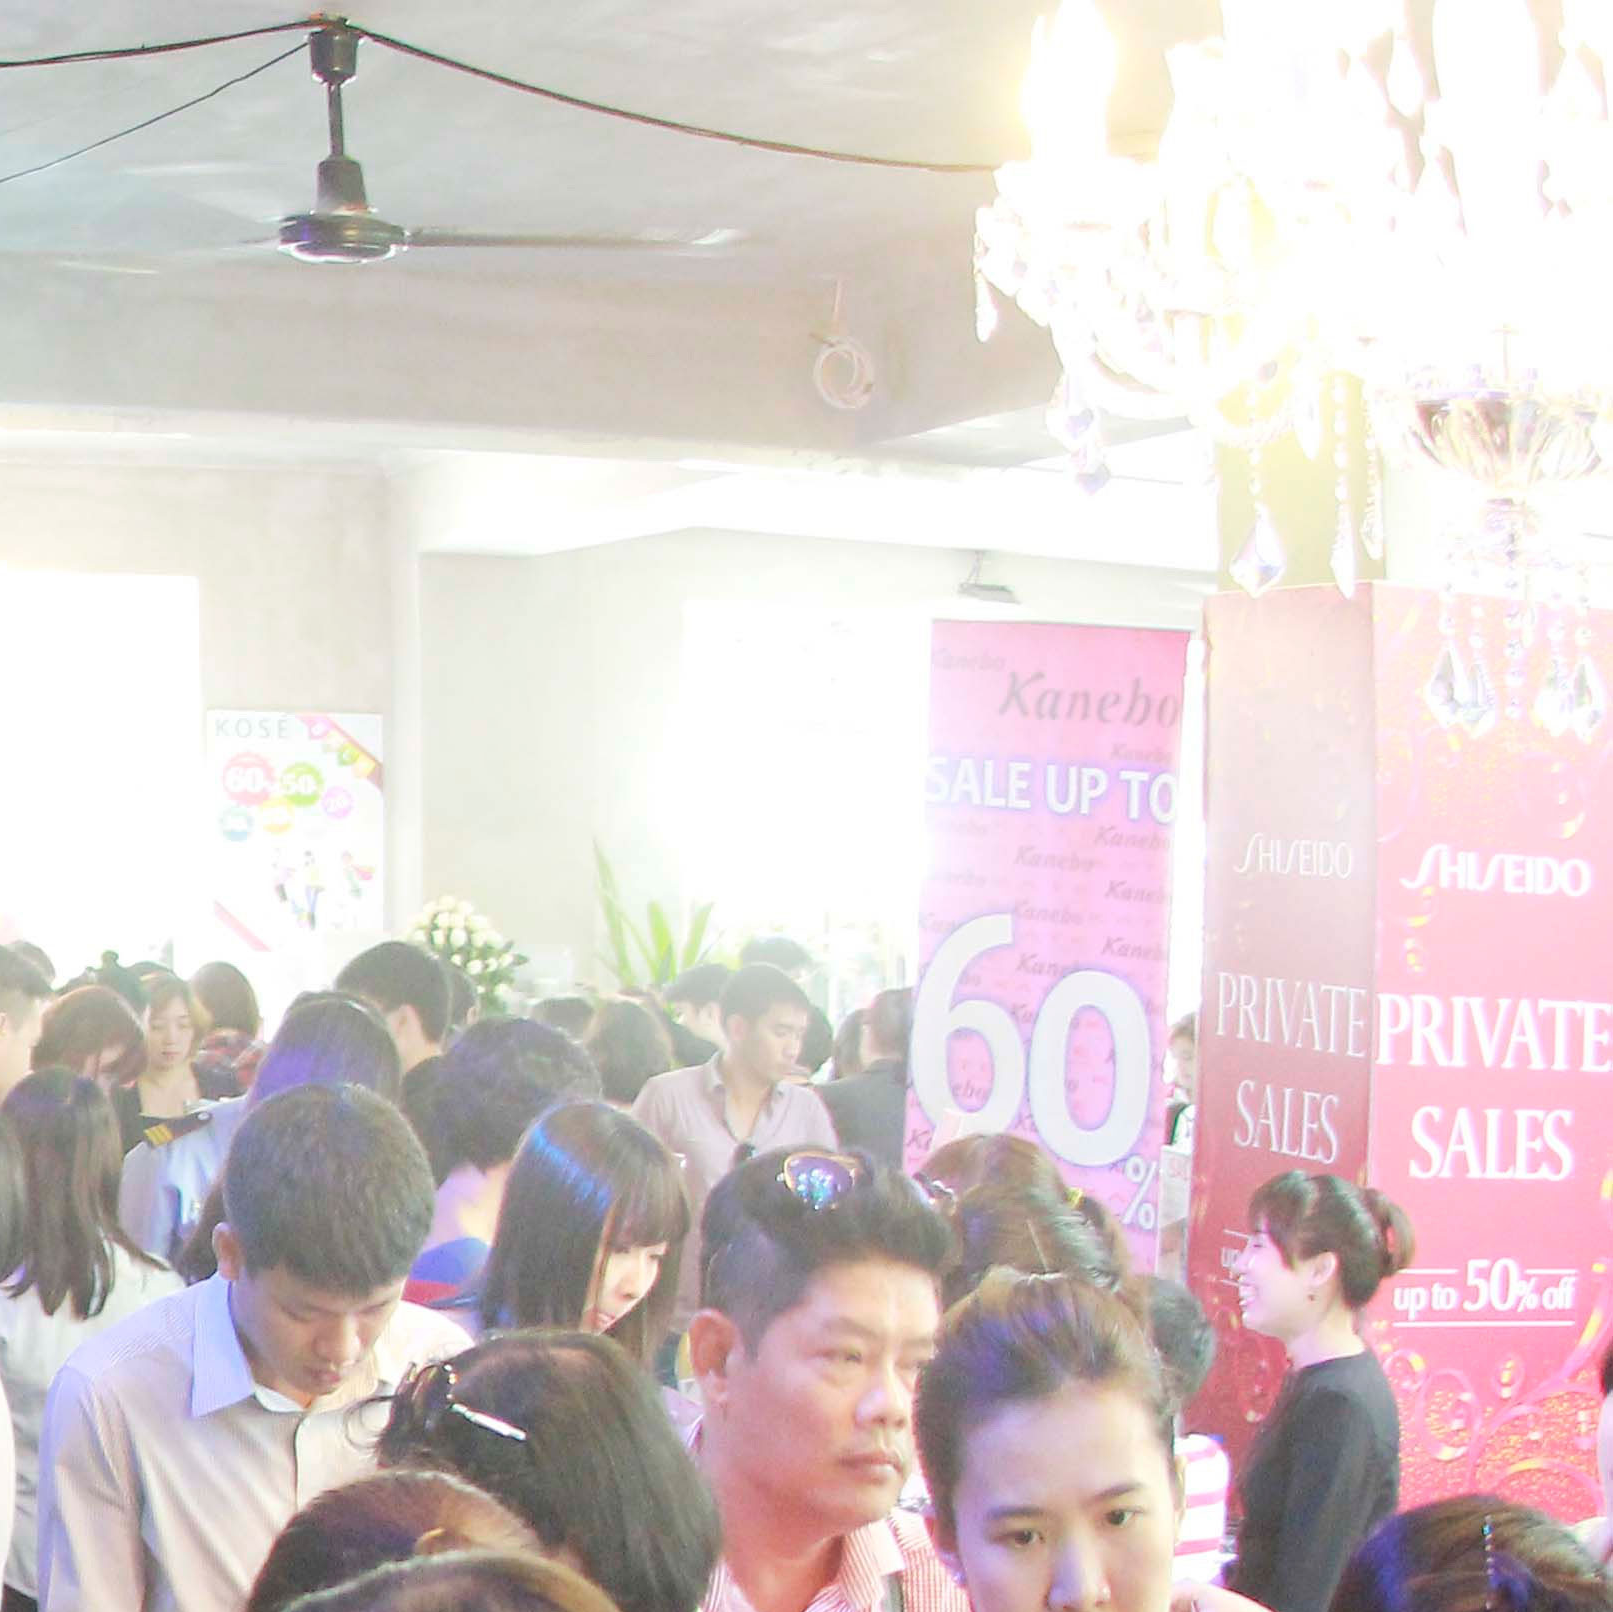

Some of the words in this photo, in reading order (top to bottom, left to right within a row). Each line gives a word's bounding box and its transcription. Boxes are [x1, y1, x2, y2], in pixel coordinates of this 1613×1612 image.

[998, 670, 1181, 729] Kanebo
[926, 755, 1032, 810] SALE
[1045, 763, 1108, 816] UP
[1119, 770, 1177, 825] TO
[1233, 833, 1355, 879] SHISEIDO
[1400, 843, 1594, 898] SHISEIDO
[1215, 971, 1368, 1059] PRIVATE
[1377, 992, 1613, 1073] PRIVATE
[1233, 1079, 1340, 1165] SALES
[1408, 1106, 1574, 1181] SALES
[1392, 1286, 1428, 1320] up
[1431, 1281, 1458, 1311] to
[1462, 1257, 1539, 1313] 50%
[1542, 1275, 1577, 1310] off
